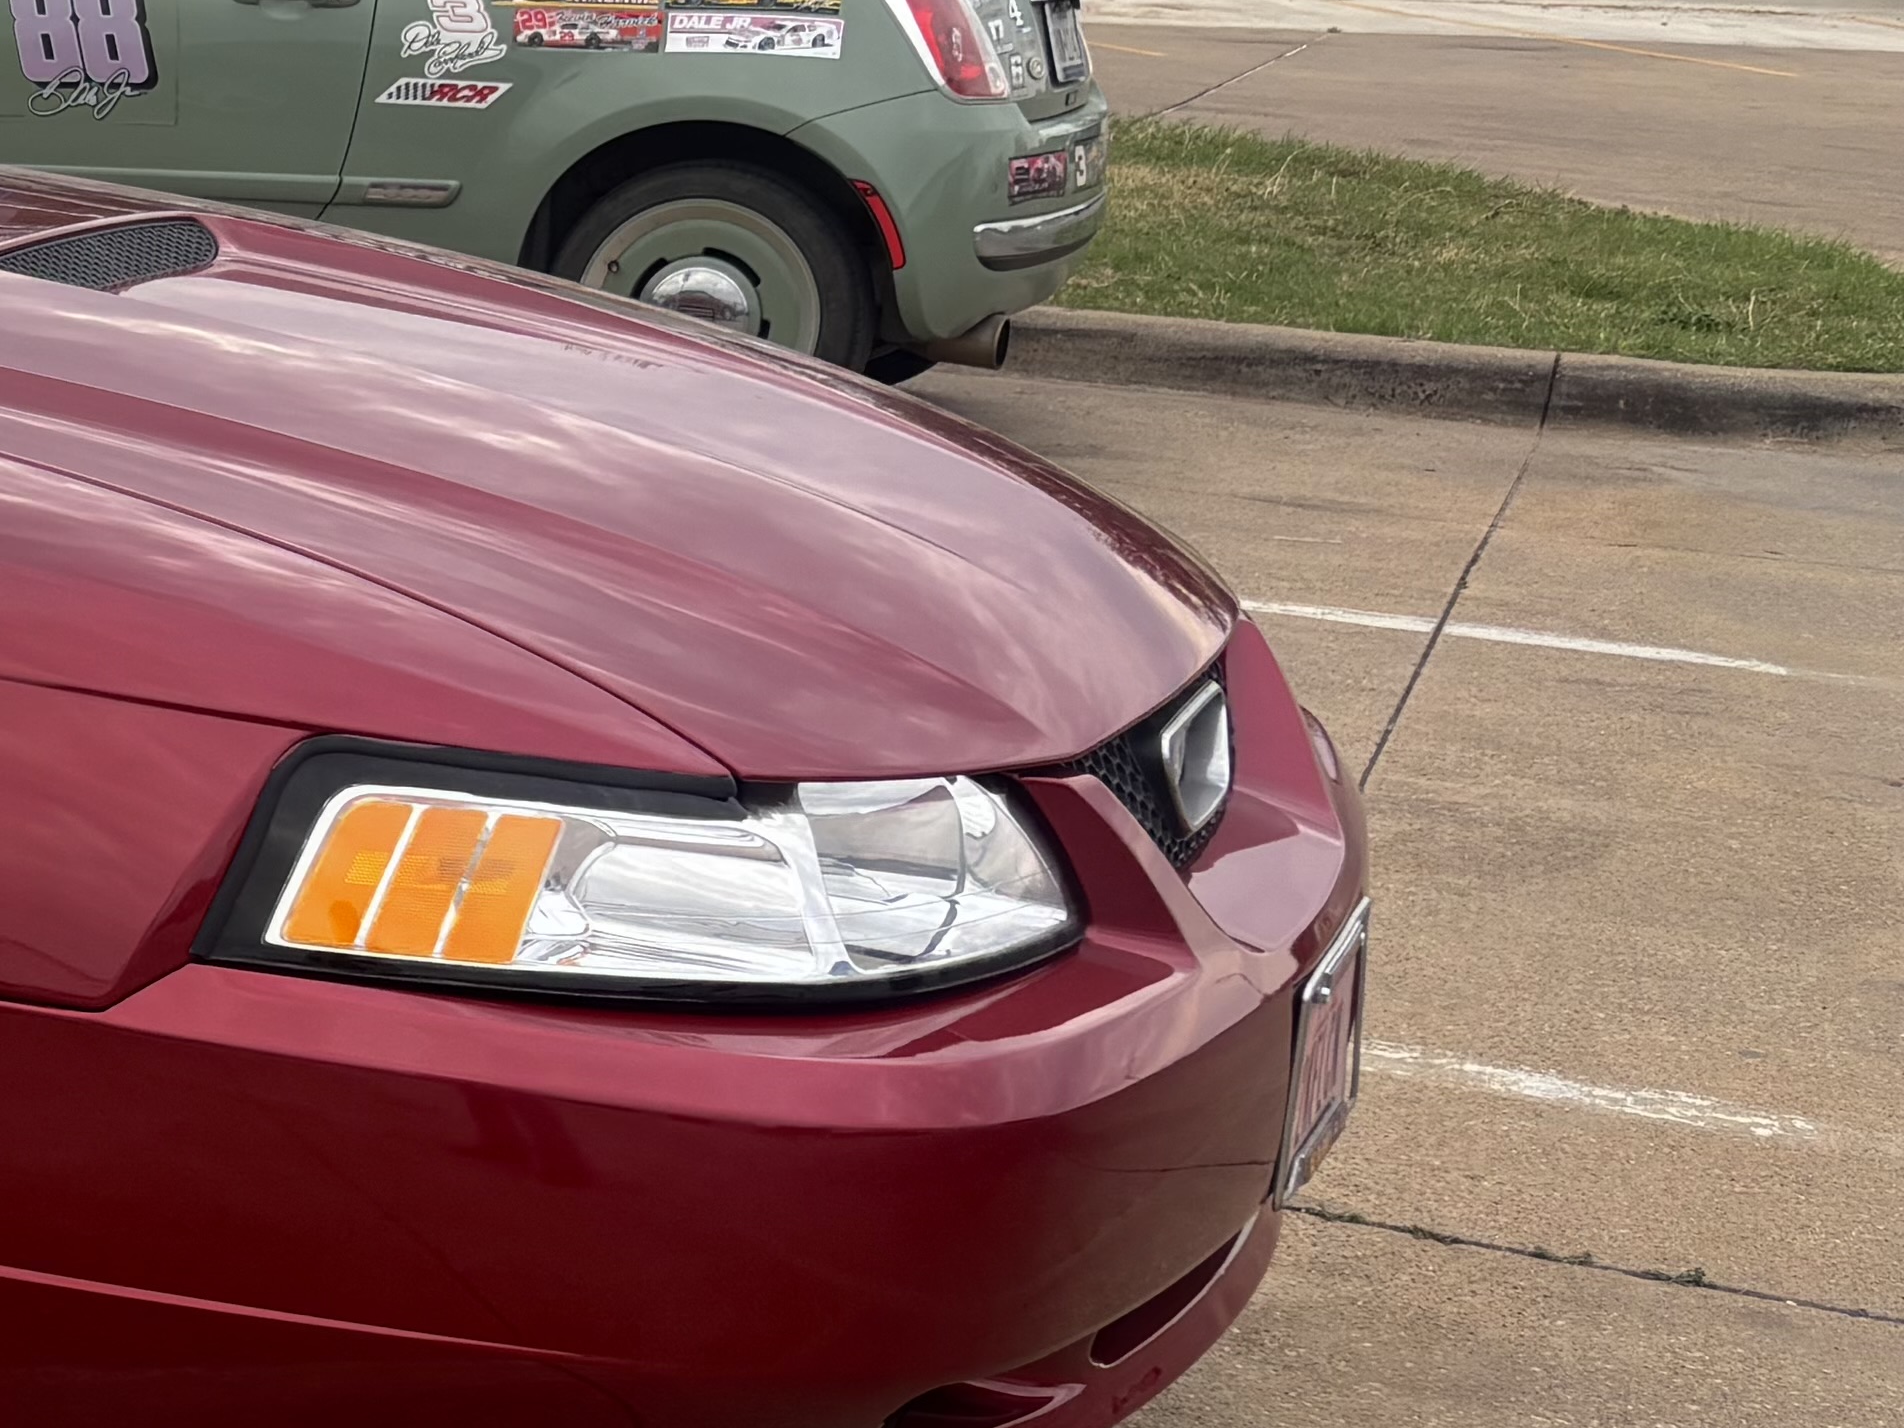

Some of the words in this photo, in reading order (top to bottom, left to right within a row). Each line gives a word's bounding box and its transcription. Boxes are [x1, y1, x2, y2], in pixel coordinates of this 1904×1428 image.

[517, 8, 548, 31] 29
[673, 15, 724, 29] DALE
[427, 83, 499, 104] RCR
[1074, 145, 1087, 187] 3
